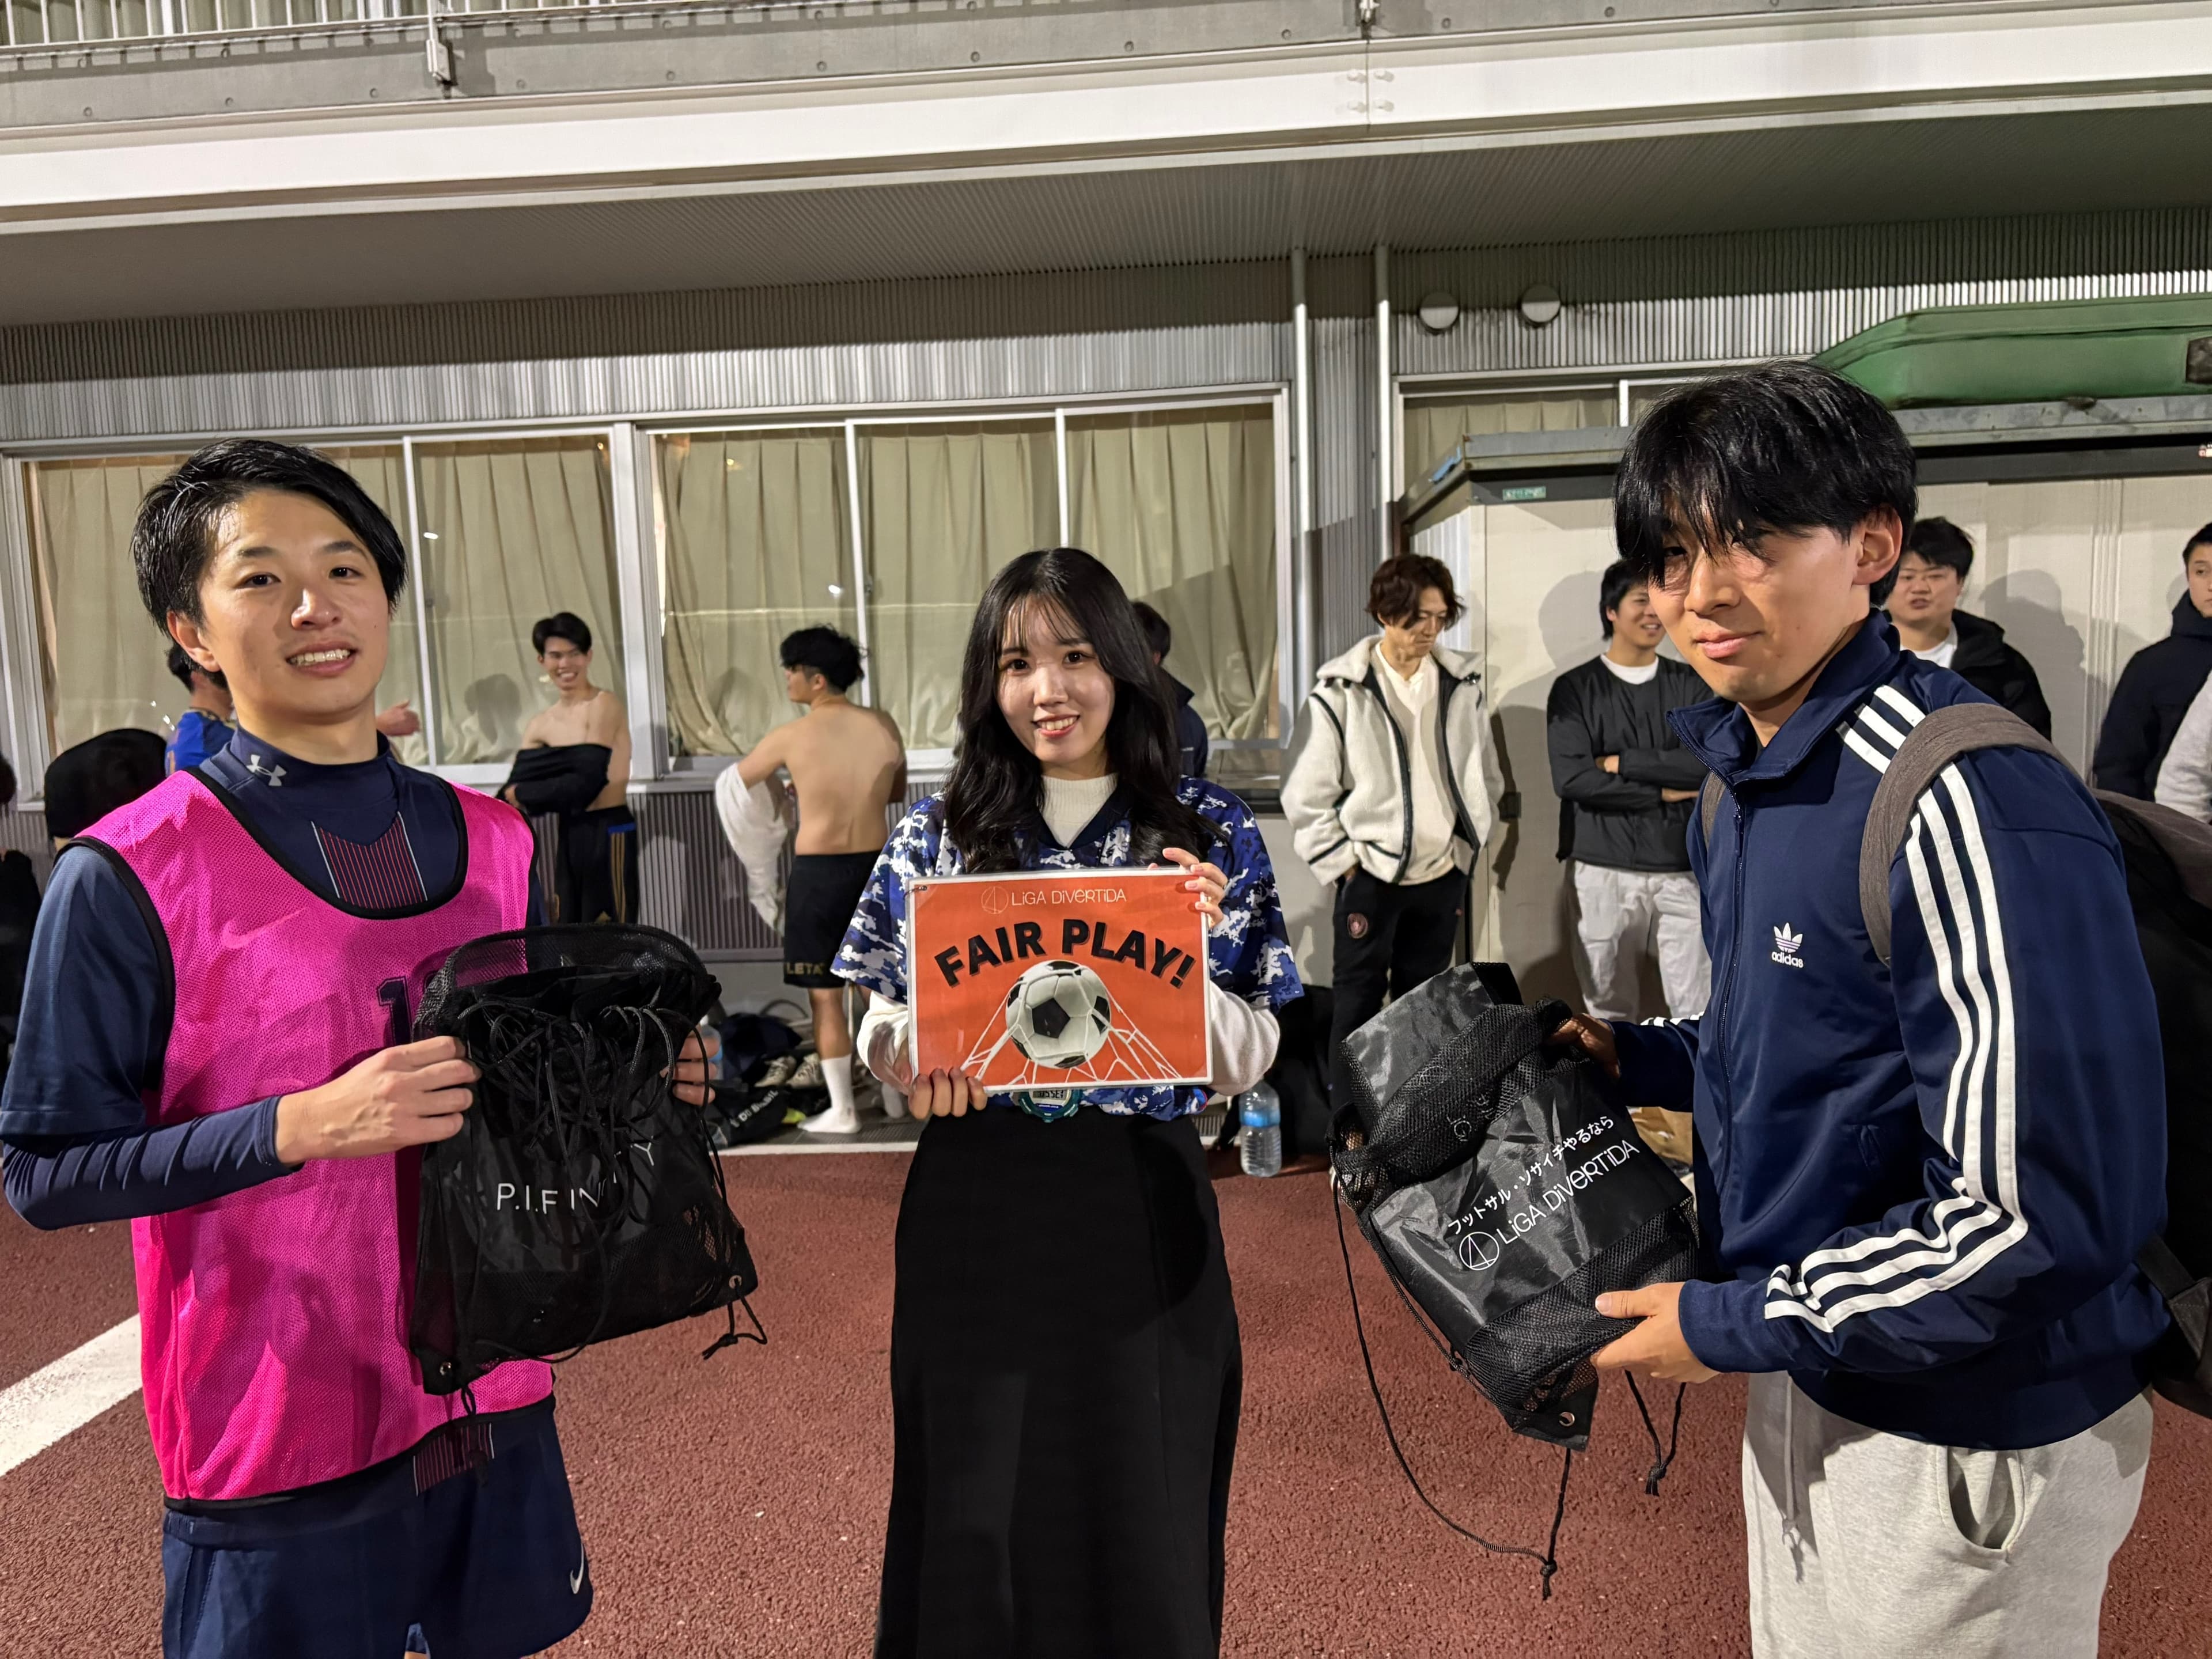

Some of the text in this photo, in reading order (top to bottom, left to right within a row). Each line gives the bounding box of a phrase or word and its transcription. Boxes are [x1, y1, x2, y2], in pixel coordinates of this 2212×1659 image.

[934, 918, 1196, 990] FAIR PLAY!
[1771, 951, 1804, 968] adidas
